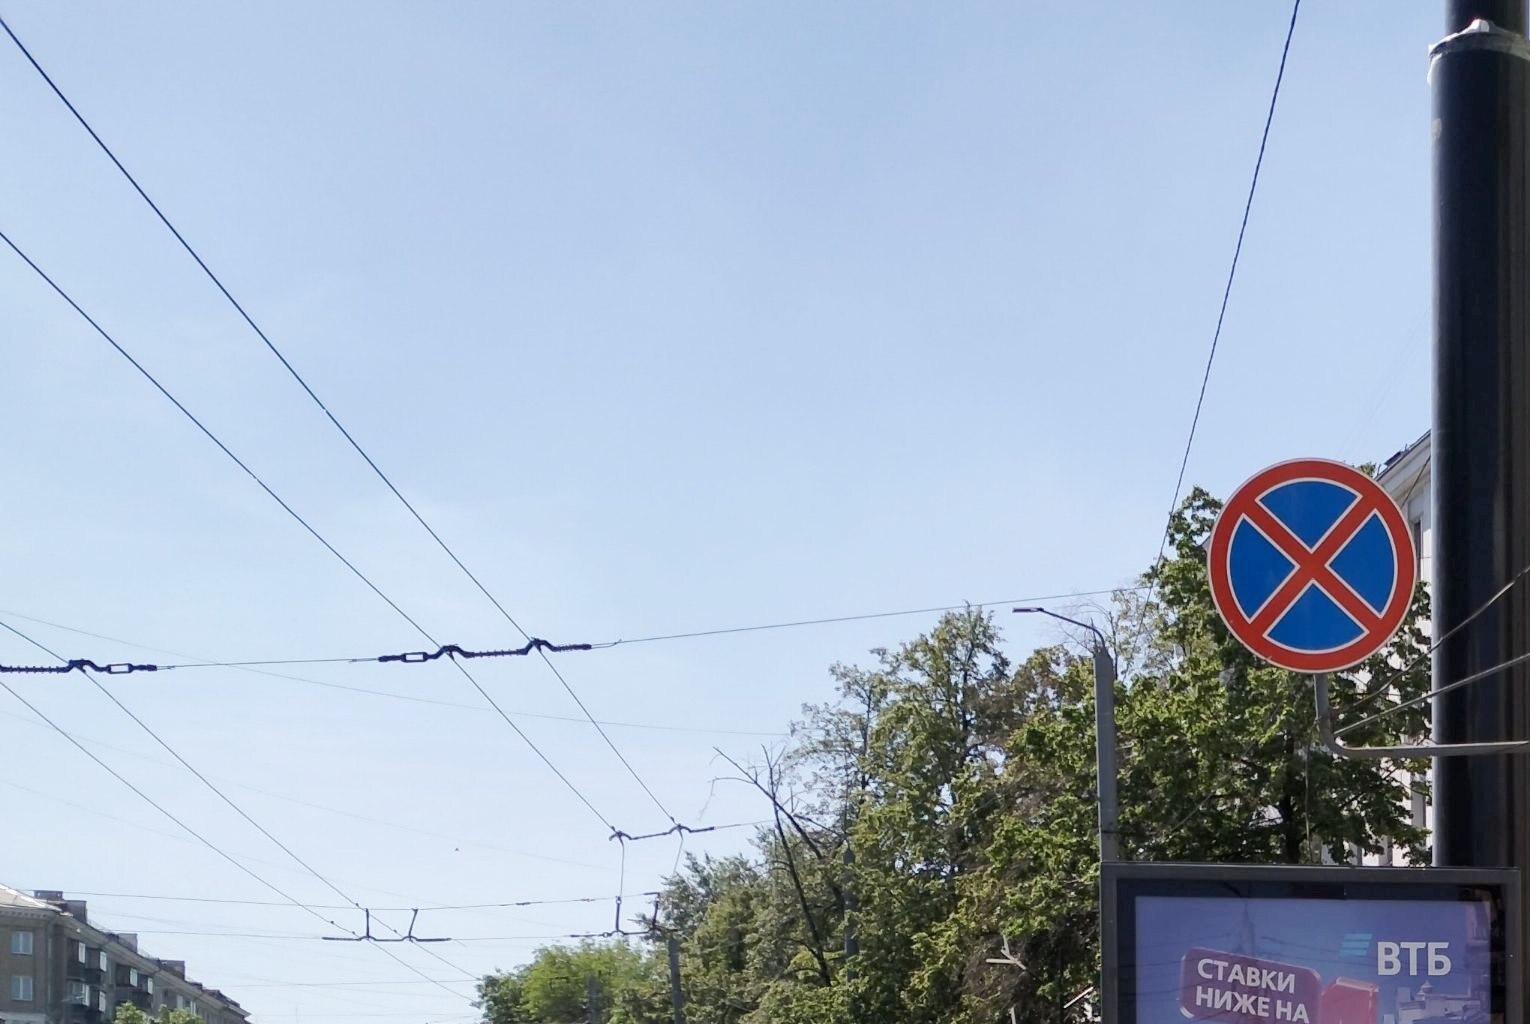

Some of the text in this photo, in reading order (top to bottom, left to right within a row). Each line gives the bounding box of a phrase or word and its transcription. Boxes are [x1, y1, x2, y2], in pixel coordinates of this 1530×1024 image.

[1197, 958, 1296, 994] СТАВКИ
[1377, 941, 1451, 976] ВТБ
[1195, 985, 1310, 1024] НИЖЕ НА
